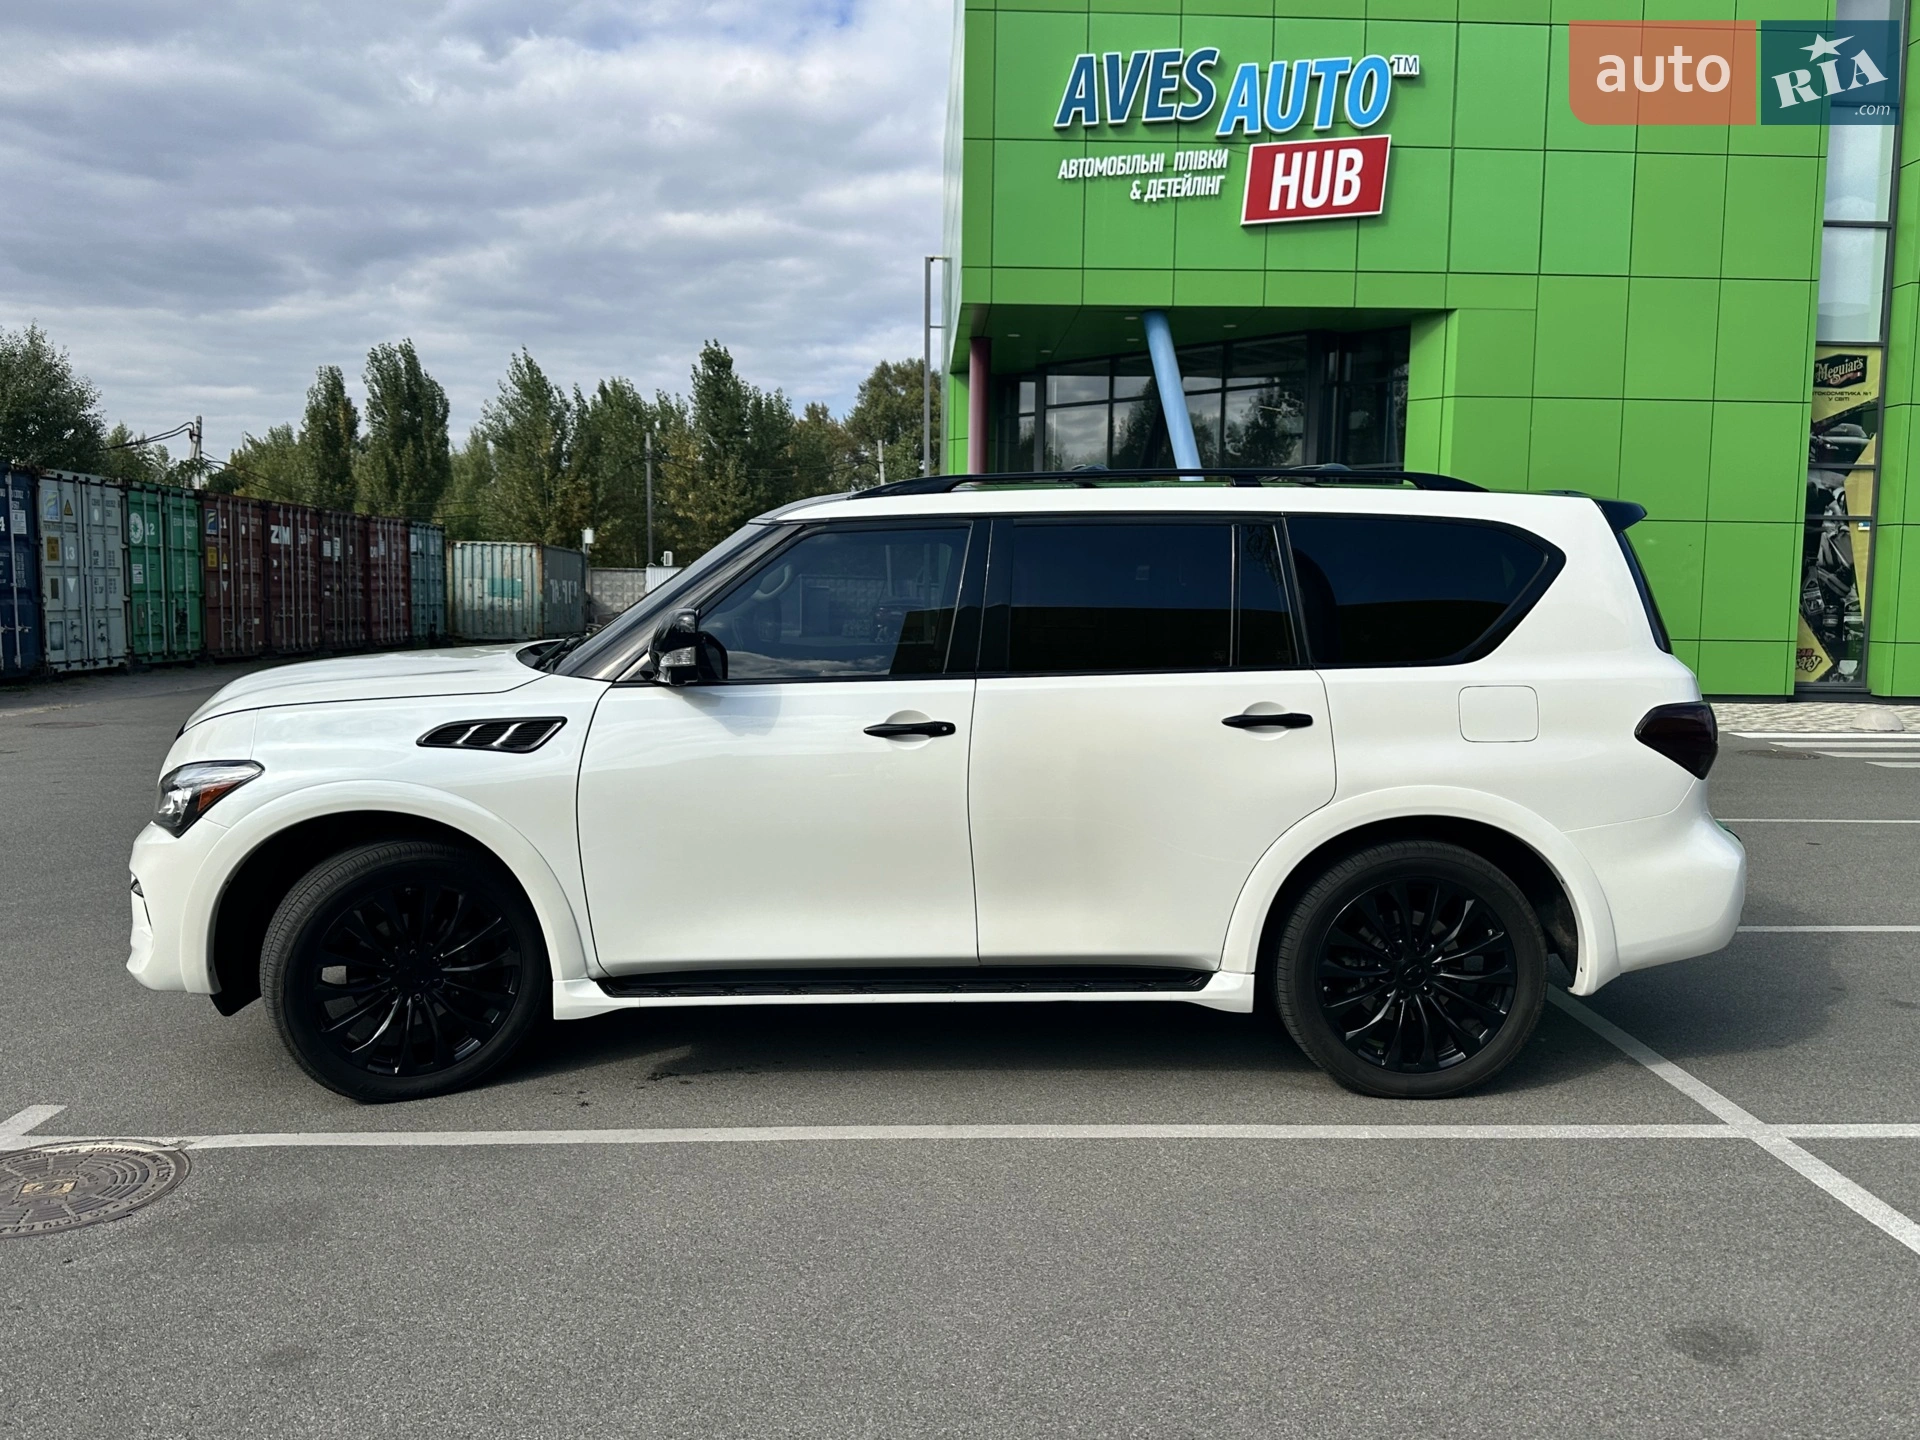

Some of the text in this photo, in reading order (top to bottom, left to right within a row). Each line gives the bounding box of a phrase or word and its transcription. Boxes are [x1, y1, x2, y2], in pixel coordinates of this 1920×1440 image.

[1053, 47, 1220, 128] AVES
[1215, 55, 1392, 137] AUTO
[1058, 148, 1229, 181] АВТОМОБІЛЬНІ ПЛІВКИ
[1129, 175, 1226, 203] & ДЕТЕЙЛІНГ
[1268, 148, 1364, 212] HUB
[1815, 357, 1864, 384] Meguiar's
[270, 525, 291, 546] ZIM
[65, 546, 75, 560] 13
